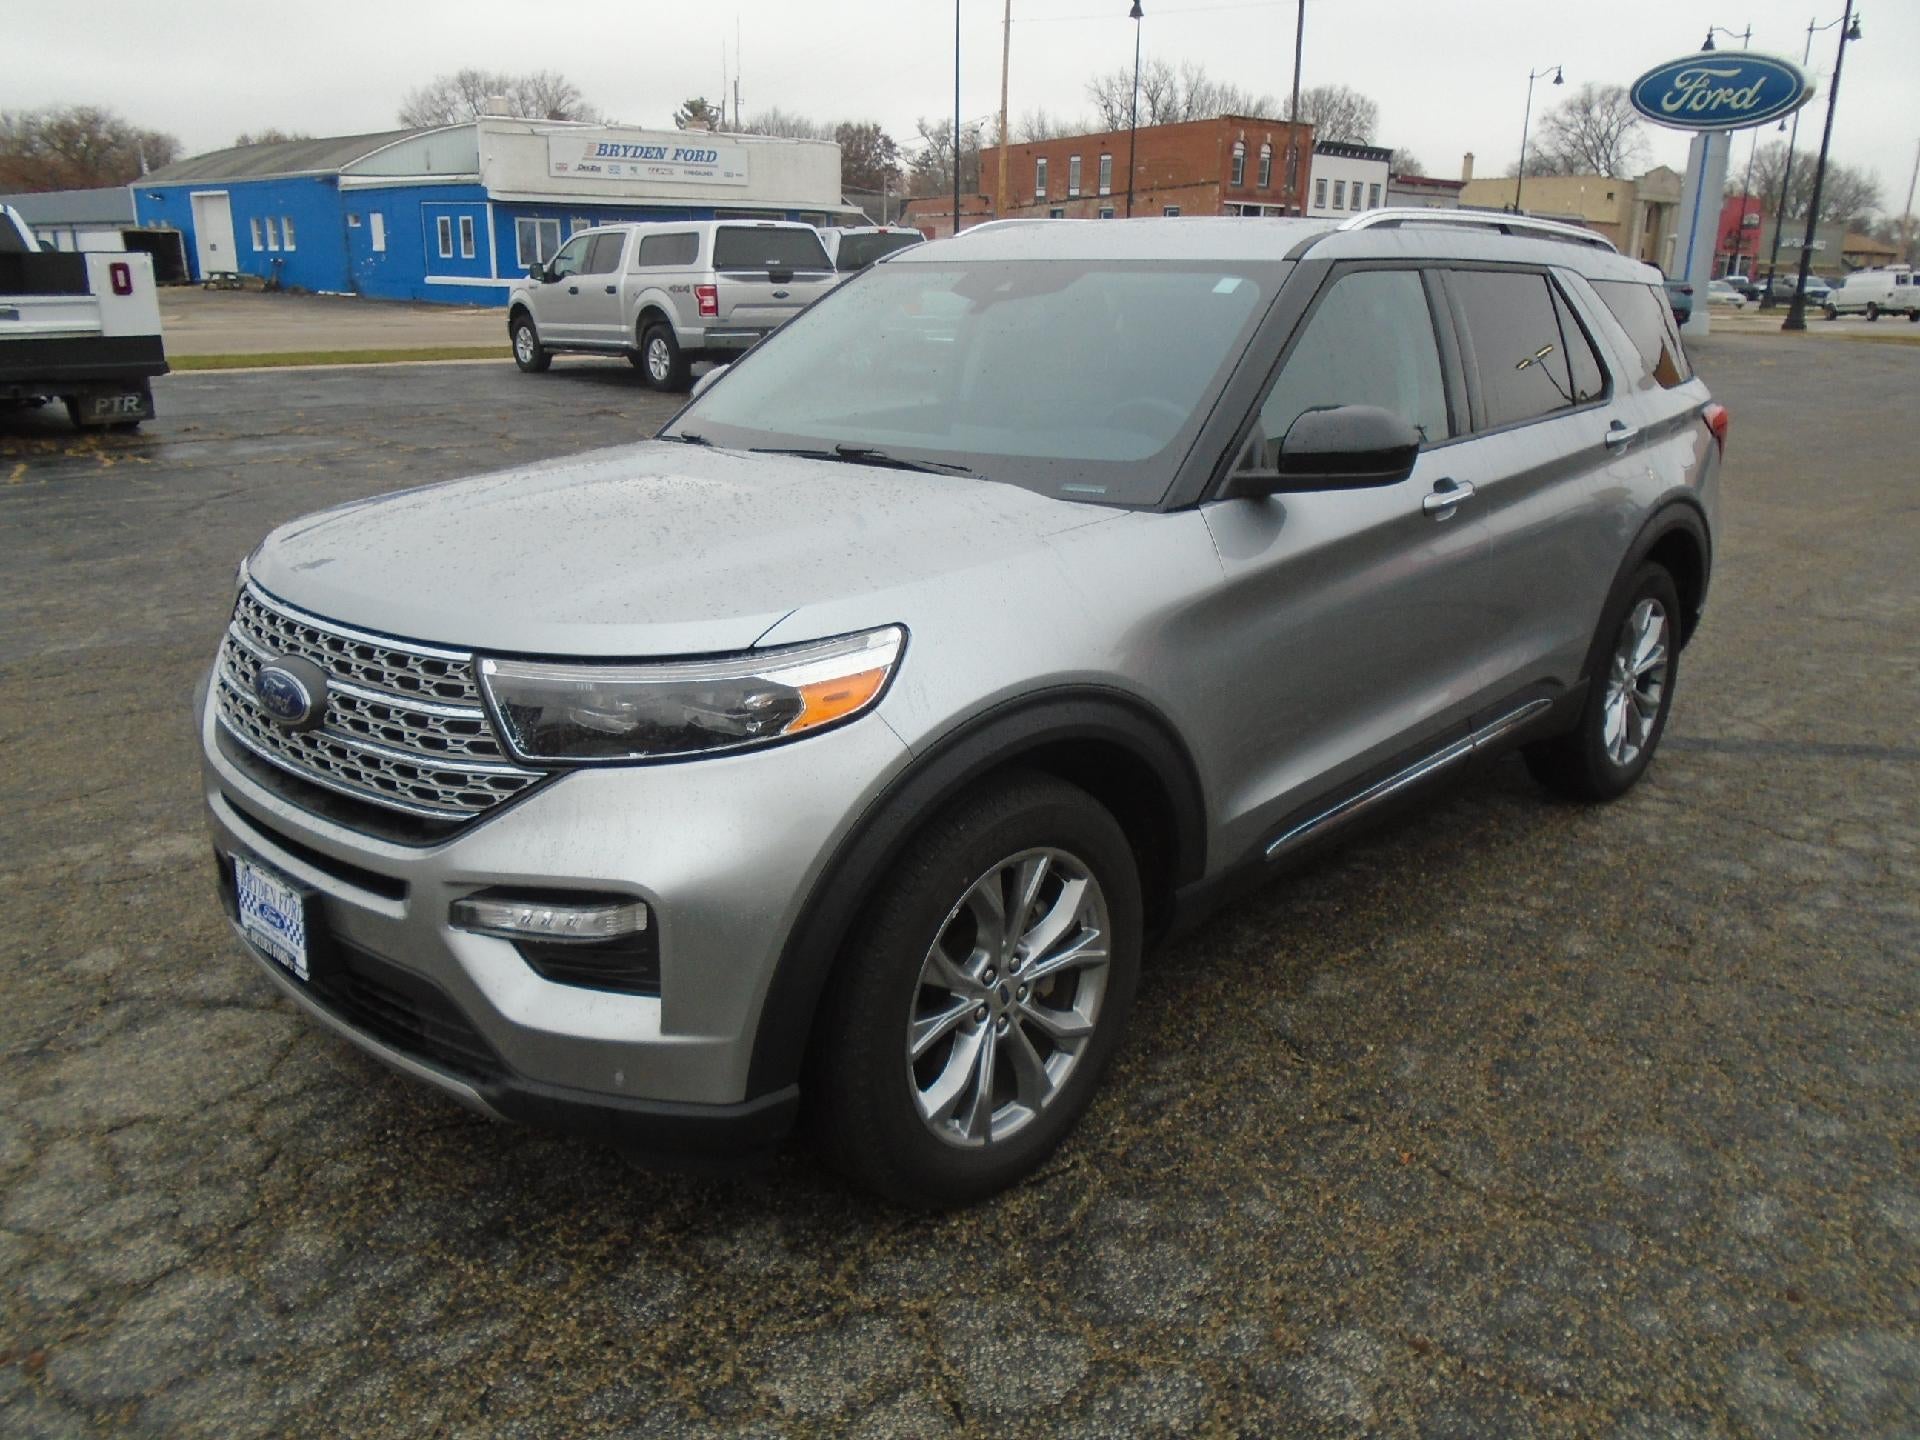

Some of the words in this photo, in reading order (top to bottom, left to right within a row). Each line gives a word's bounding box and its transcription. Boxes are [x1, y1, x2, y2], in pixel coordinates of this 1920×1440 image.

[1661, 67, 1768, 113] Ford
[595, 143, 668, 160] BRYDEN
[672, 148, 718, 162] FORD
[95, 395, 140, 414] PTR
[262, 904, 284, 928] Ford
